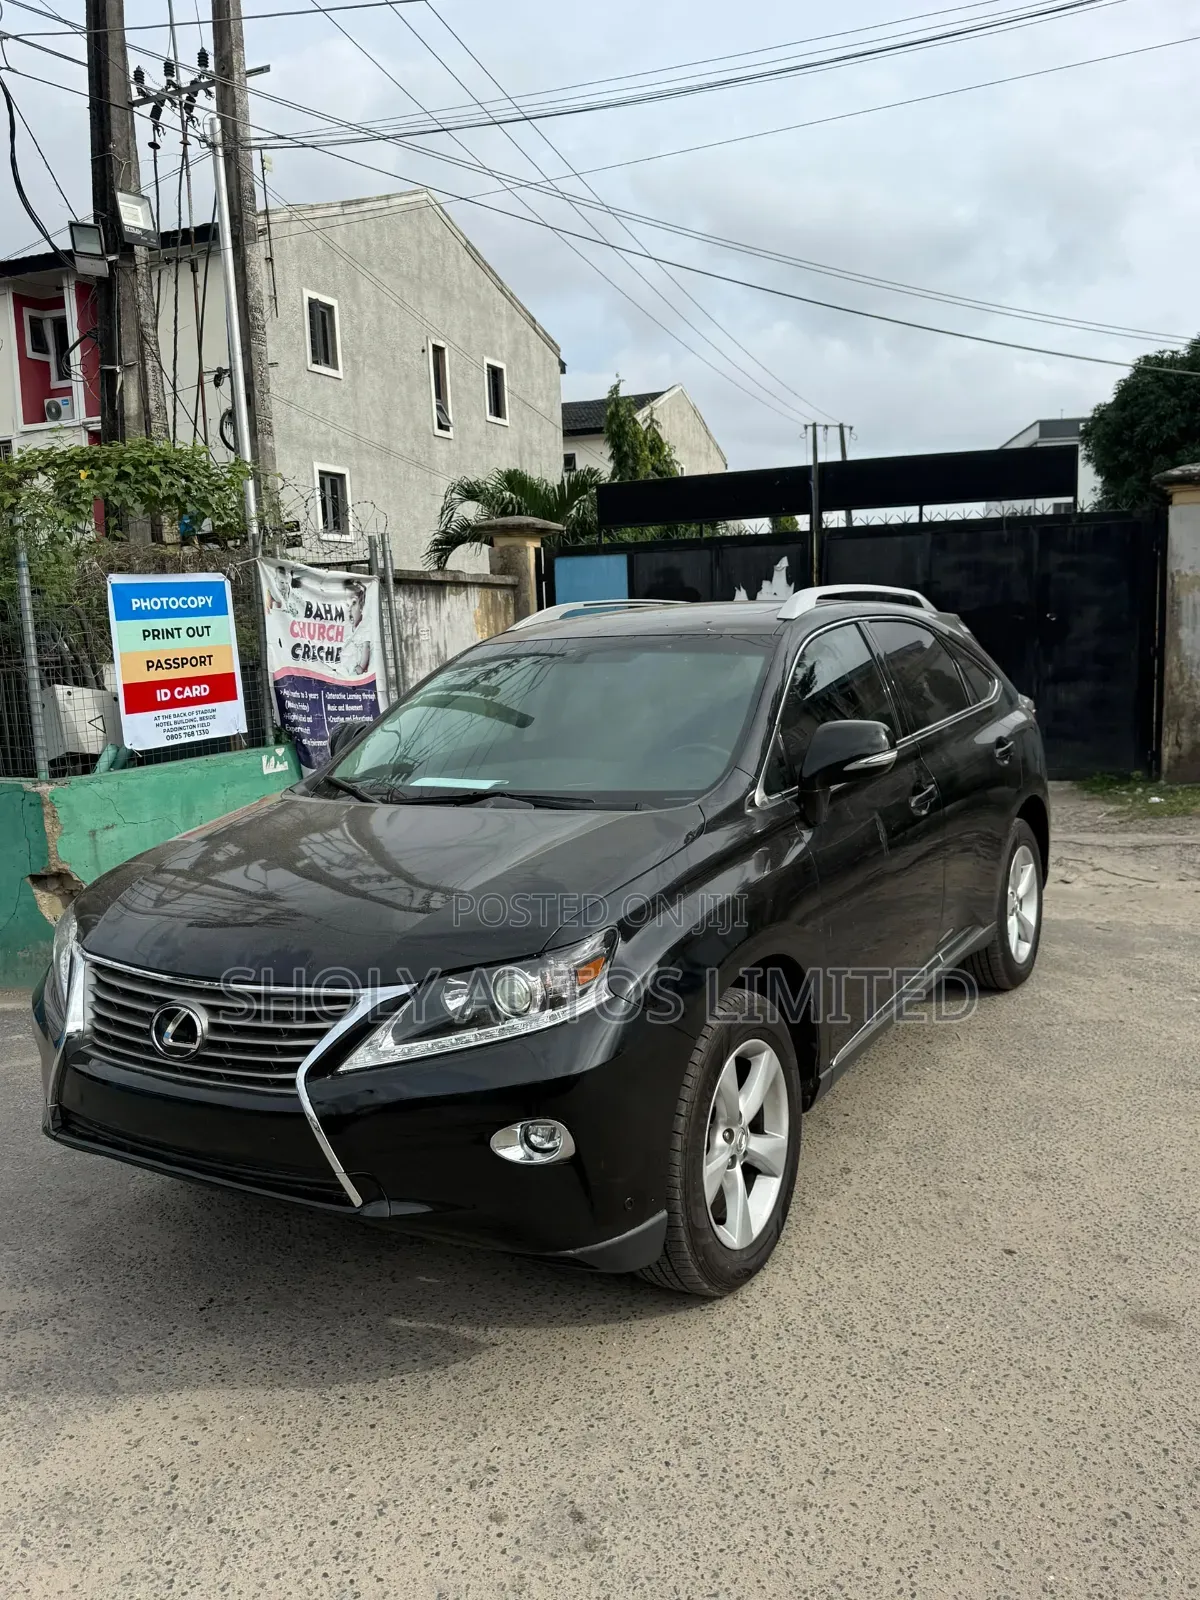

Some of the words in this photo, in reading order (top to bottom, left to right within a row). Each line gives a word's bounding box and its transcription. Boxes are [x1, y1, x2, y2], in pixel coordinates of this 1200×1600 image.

[131, 595, 213, 611] PHOTOCOPY
[304, 600, 345, 622] BAHM
[142, 627, 182, 641] PRINT
[186, 625, 211, 638] OUT
[289, 619, 345, 642] CHURCH
[146, 654, 213, 672] PASSPORT
[156, 689, 171, 701] ID
[174, 684, 210, 699] CARD
[162, 724, 196, 734] PADDINGTON
[166, 732, 182, 741] 0805
